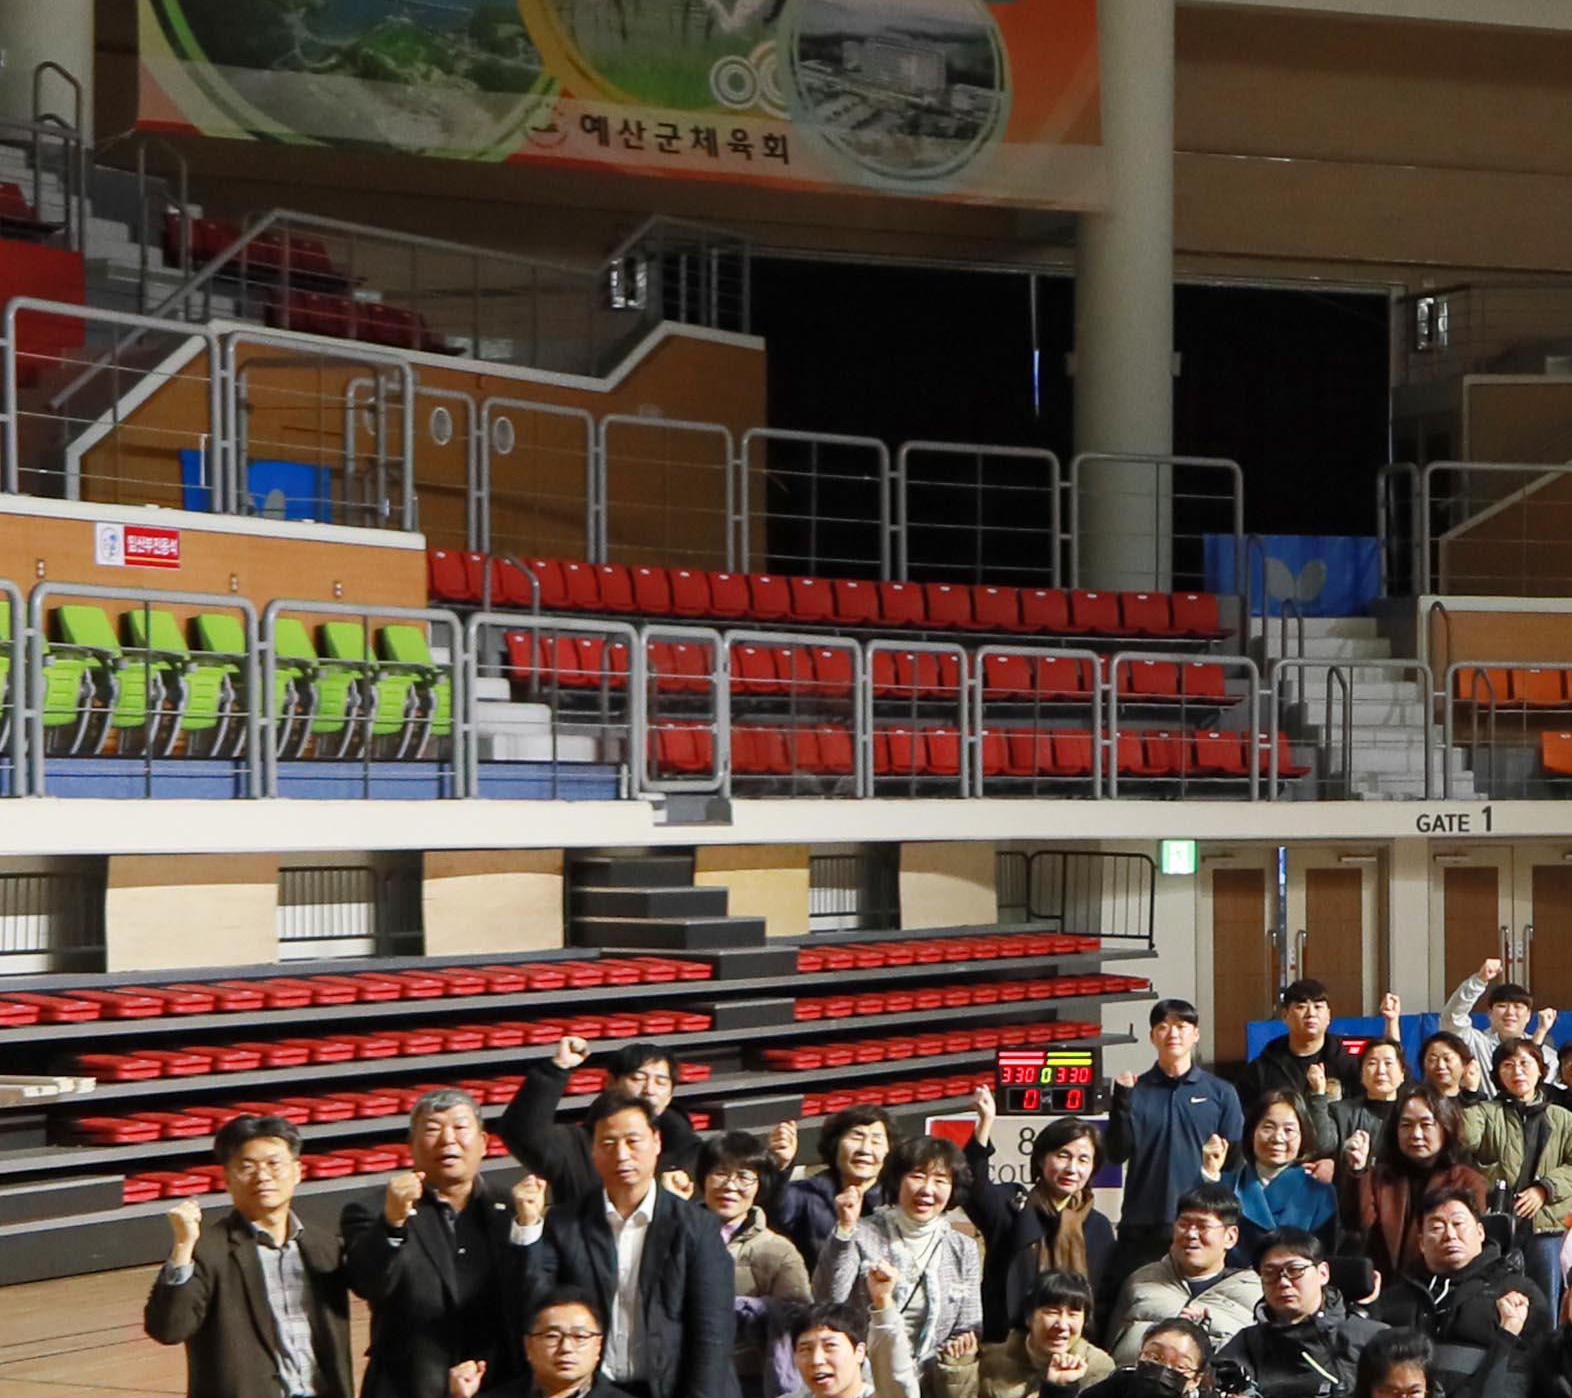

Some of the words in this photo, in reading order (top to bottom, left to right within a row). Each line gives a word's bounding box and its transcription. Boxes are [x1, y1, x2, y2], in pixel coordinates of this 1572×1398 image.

[578, 112, 792, 166] 예산군체육회
[1416, 813, 1471, 833] GATE
[1481, 806, 1493, 833] 1
